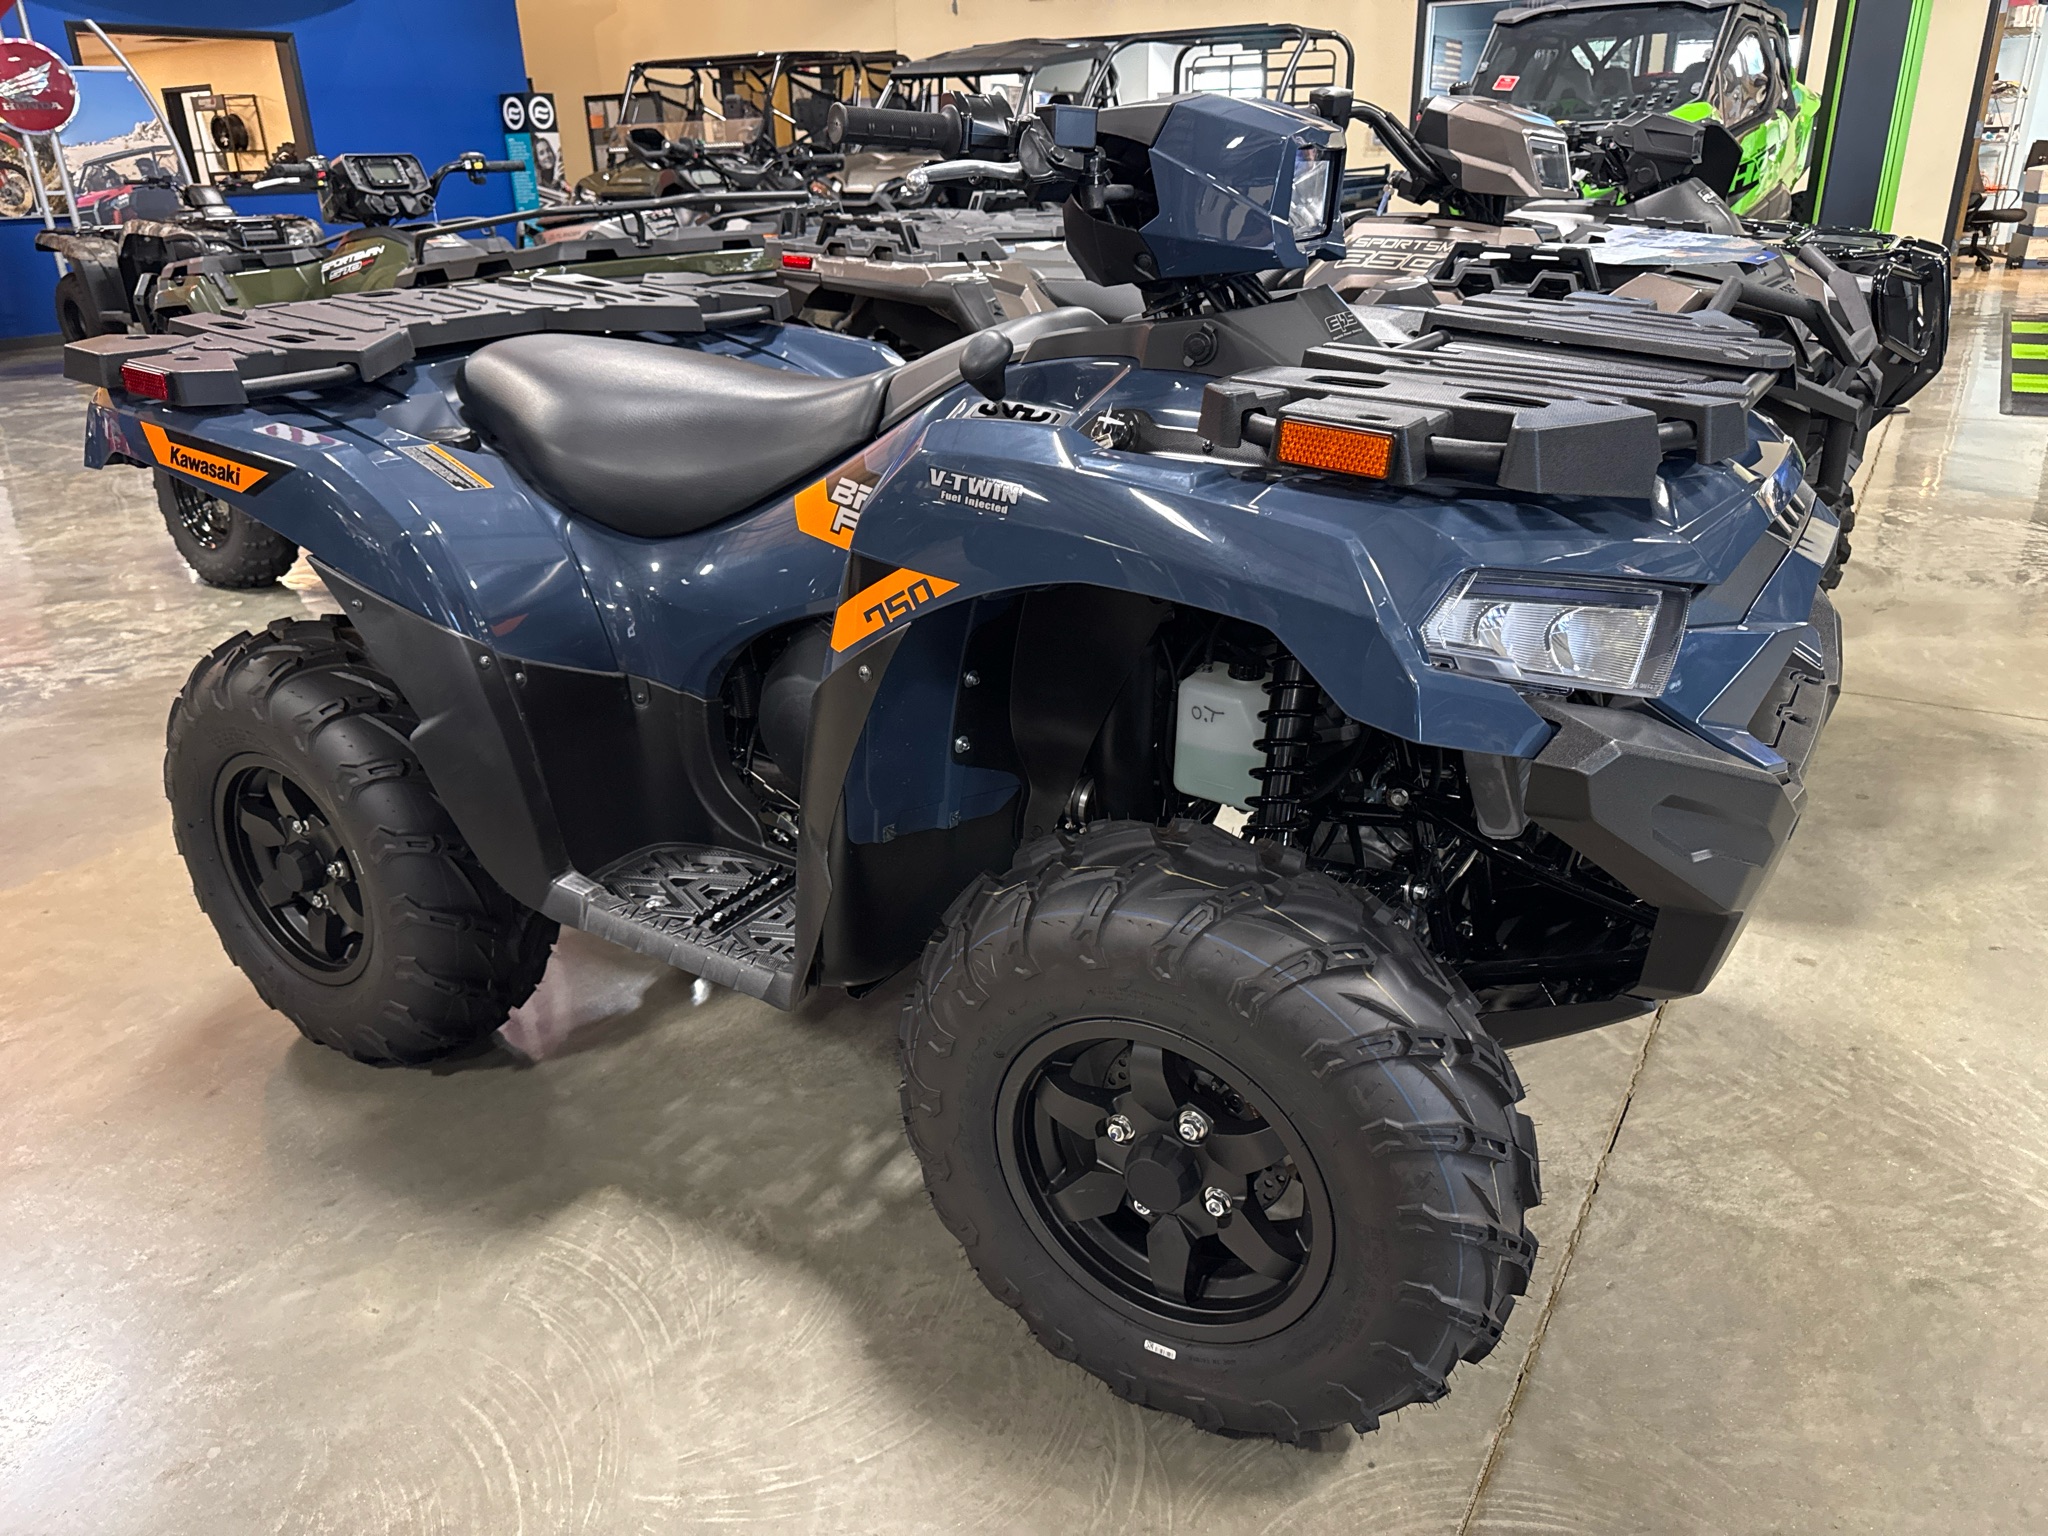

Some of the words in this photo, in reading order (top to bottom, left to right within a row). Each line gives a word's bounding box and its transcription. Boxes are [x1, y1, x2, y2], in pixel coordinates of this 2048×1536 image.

[1, 102, 64, 111] HONDA
[321, 244, 385, 273] SPORTSMAN
[169, 445, 241, 486] Kawasaki
[929, 467, 1019, 505] V-TWIN
[940, 490, 962, 503] Fuel
[964, 496, 1009, 515] Injected
[863, 578, 937, 628] 750
